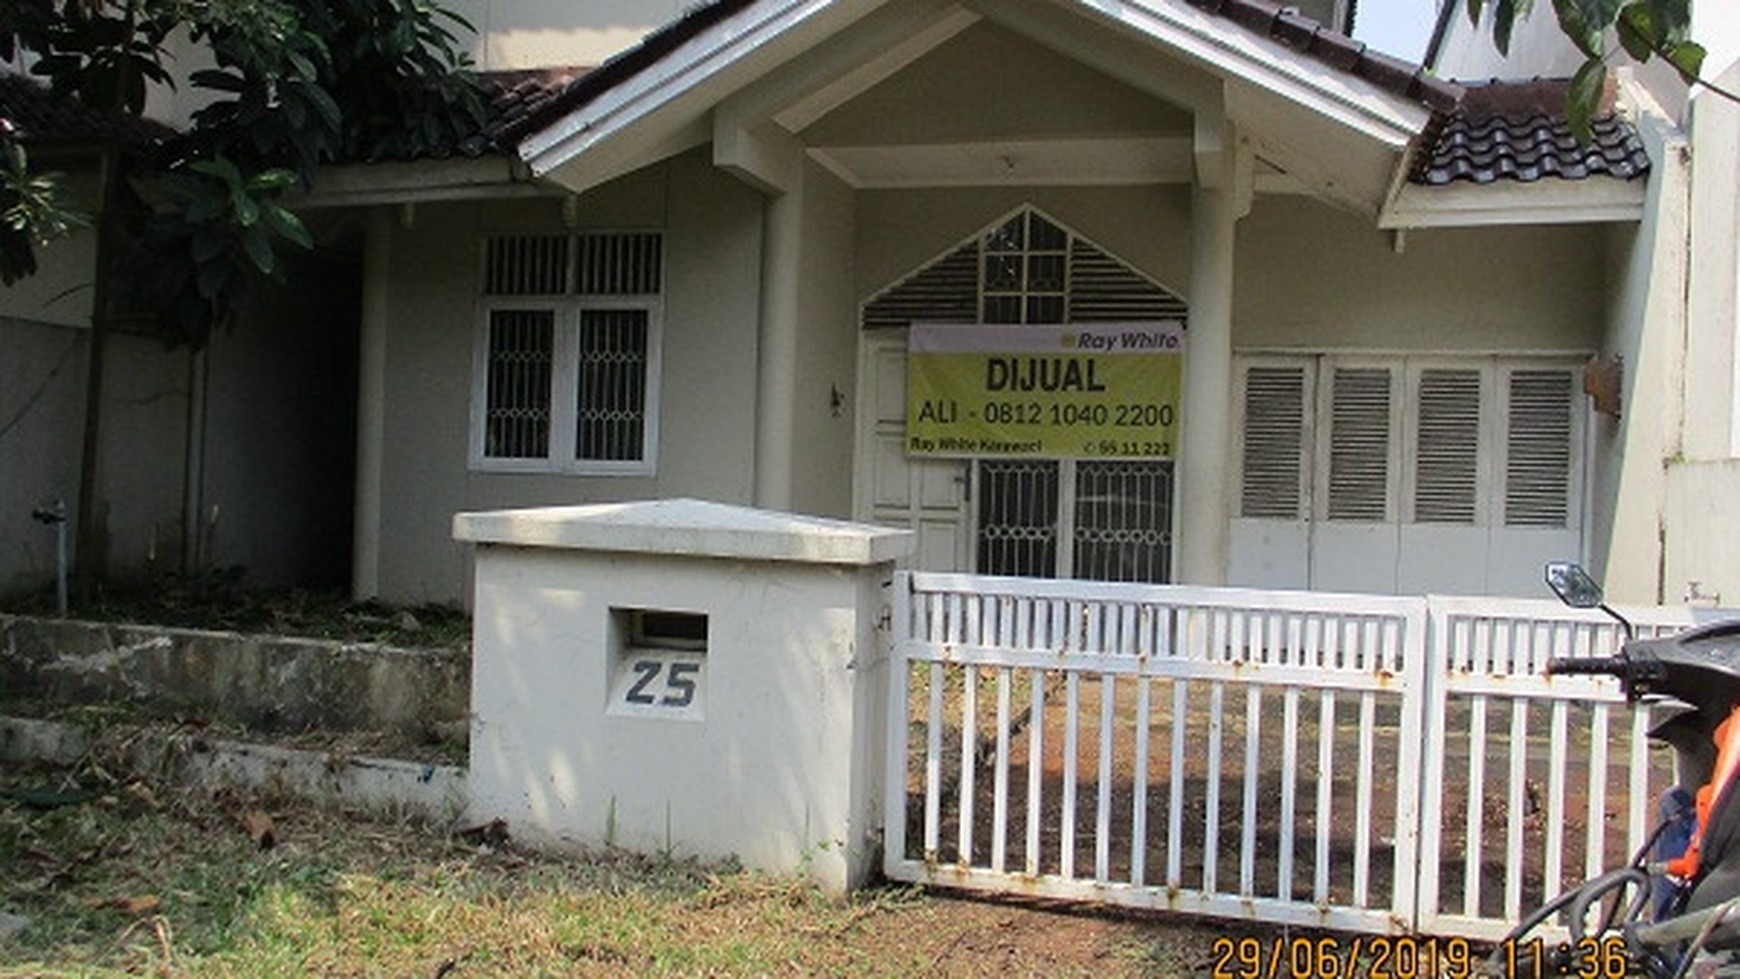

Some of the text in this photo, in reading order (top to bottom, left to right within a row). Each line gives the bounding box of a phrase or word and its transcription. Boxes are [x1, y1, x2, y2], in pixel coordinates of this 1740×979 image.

[1078, 332, 1117, 351] Ray
[986, 358, 1106, 392] DIJUAL
[918, 401, 957, 424] ALI
[984, 402, 1042, 425] 0812
[1051, 404, 1109, 426] 1040
[1115, 405, 1174, 427] 2200
[626, 661, 699, 707] 25
